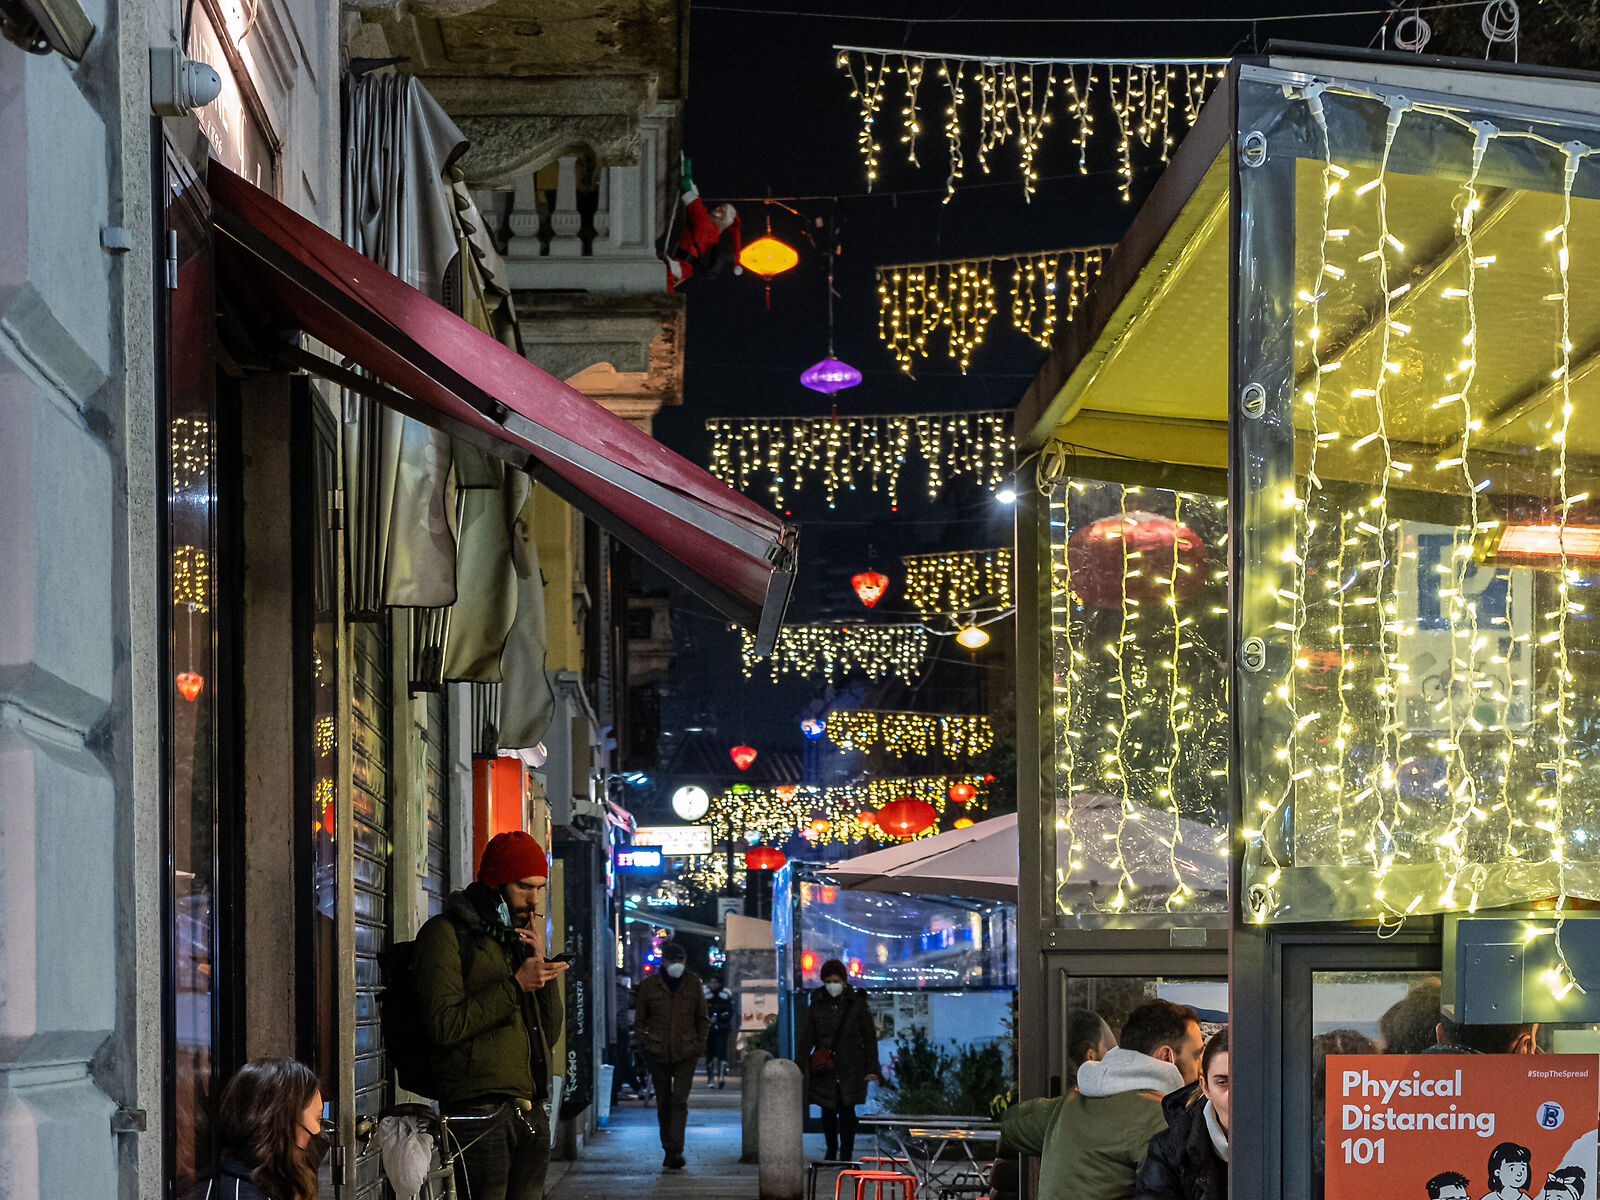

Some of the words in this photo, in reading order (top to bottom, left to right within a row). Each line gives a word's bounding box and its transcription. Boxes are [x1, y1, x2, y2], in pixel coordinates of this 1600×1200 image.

[1342, 1070, 1462, 1104] Physical
[1528, 1070, 1589, 1078] #StopTheSpread
[1342, 1104, 1495, 1137] Distancing
[1341, 1138, 1385, 1164] 101
